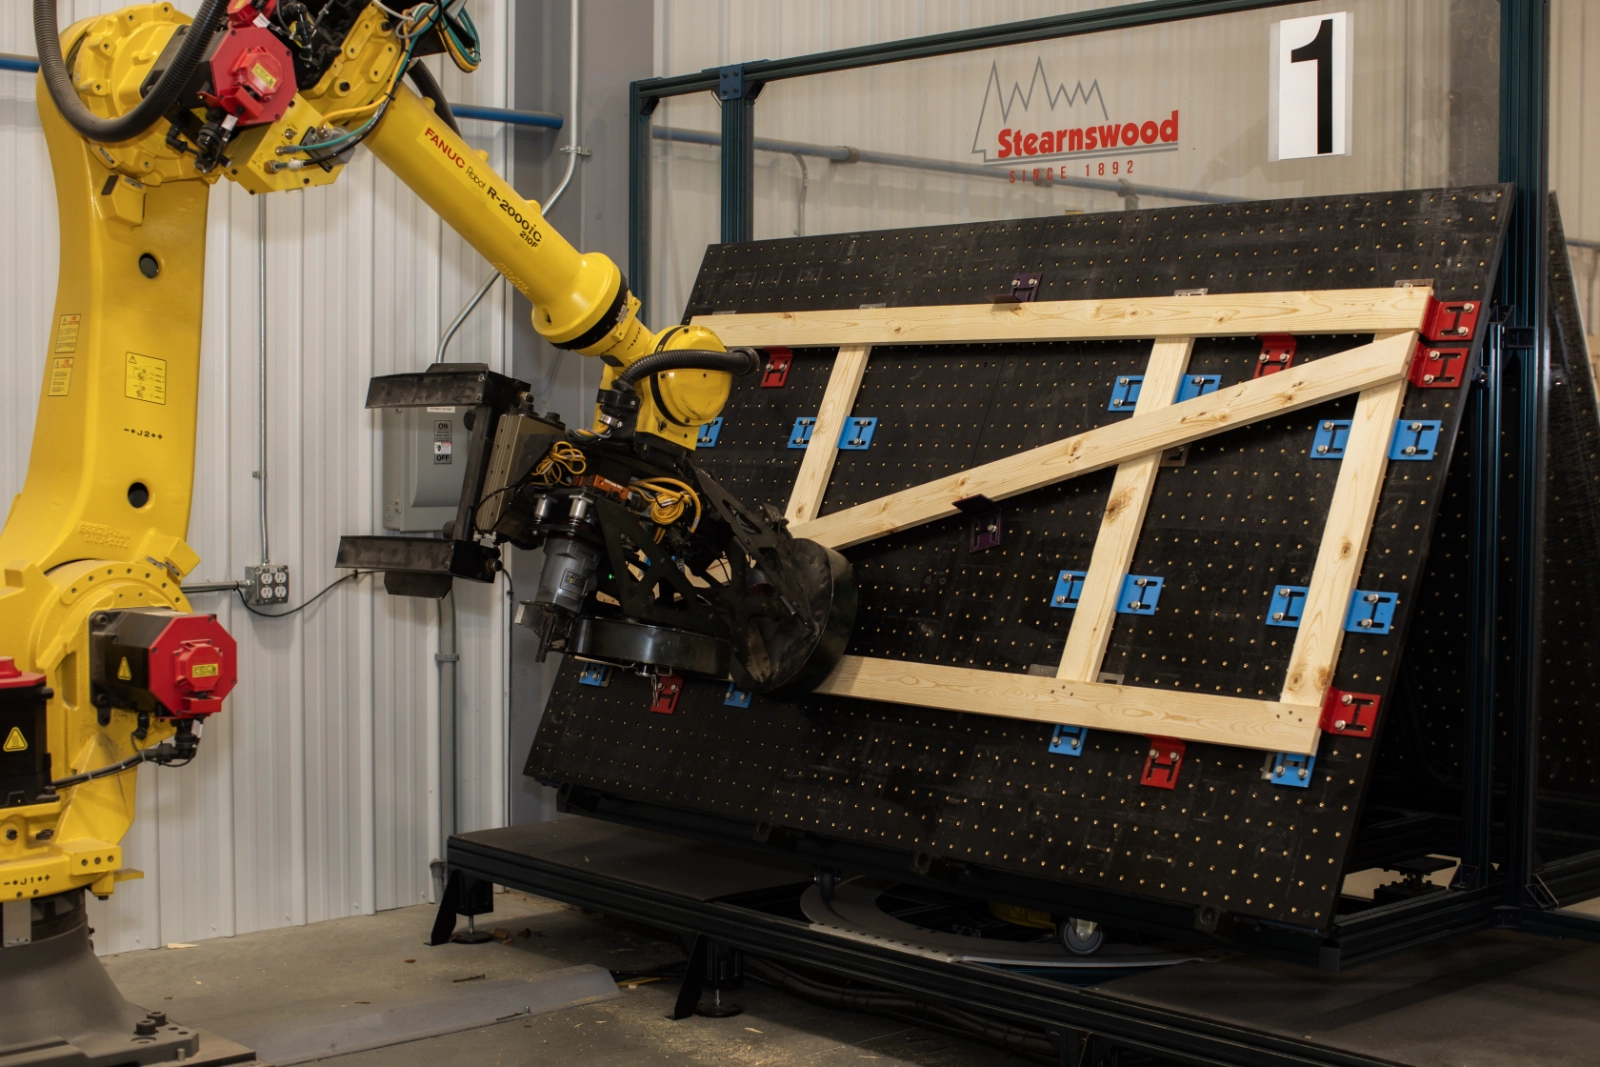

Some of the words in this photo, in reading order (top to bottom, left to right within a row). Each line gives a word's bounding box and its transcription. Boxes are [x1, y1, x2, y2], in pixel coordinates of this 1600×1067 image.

[1290, 18, 1333, 155] 1
[997, 109, 1179, 158] Stearnswood
[1009, 165, 1067, 184] SINCE
[1085, 160, 1134, 177] 1892
[424, 127, 466, 169] FANUC
[465, 165, 487, 190] Robot
[486, 186, 543, 243] R-2000iC
[519, 230, 539, 249] 210F
[437, 422, 449, 430] ON
[436, 454, 450, 462] OFF
